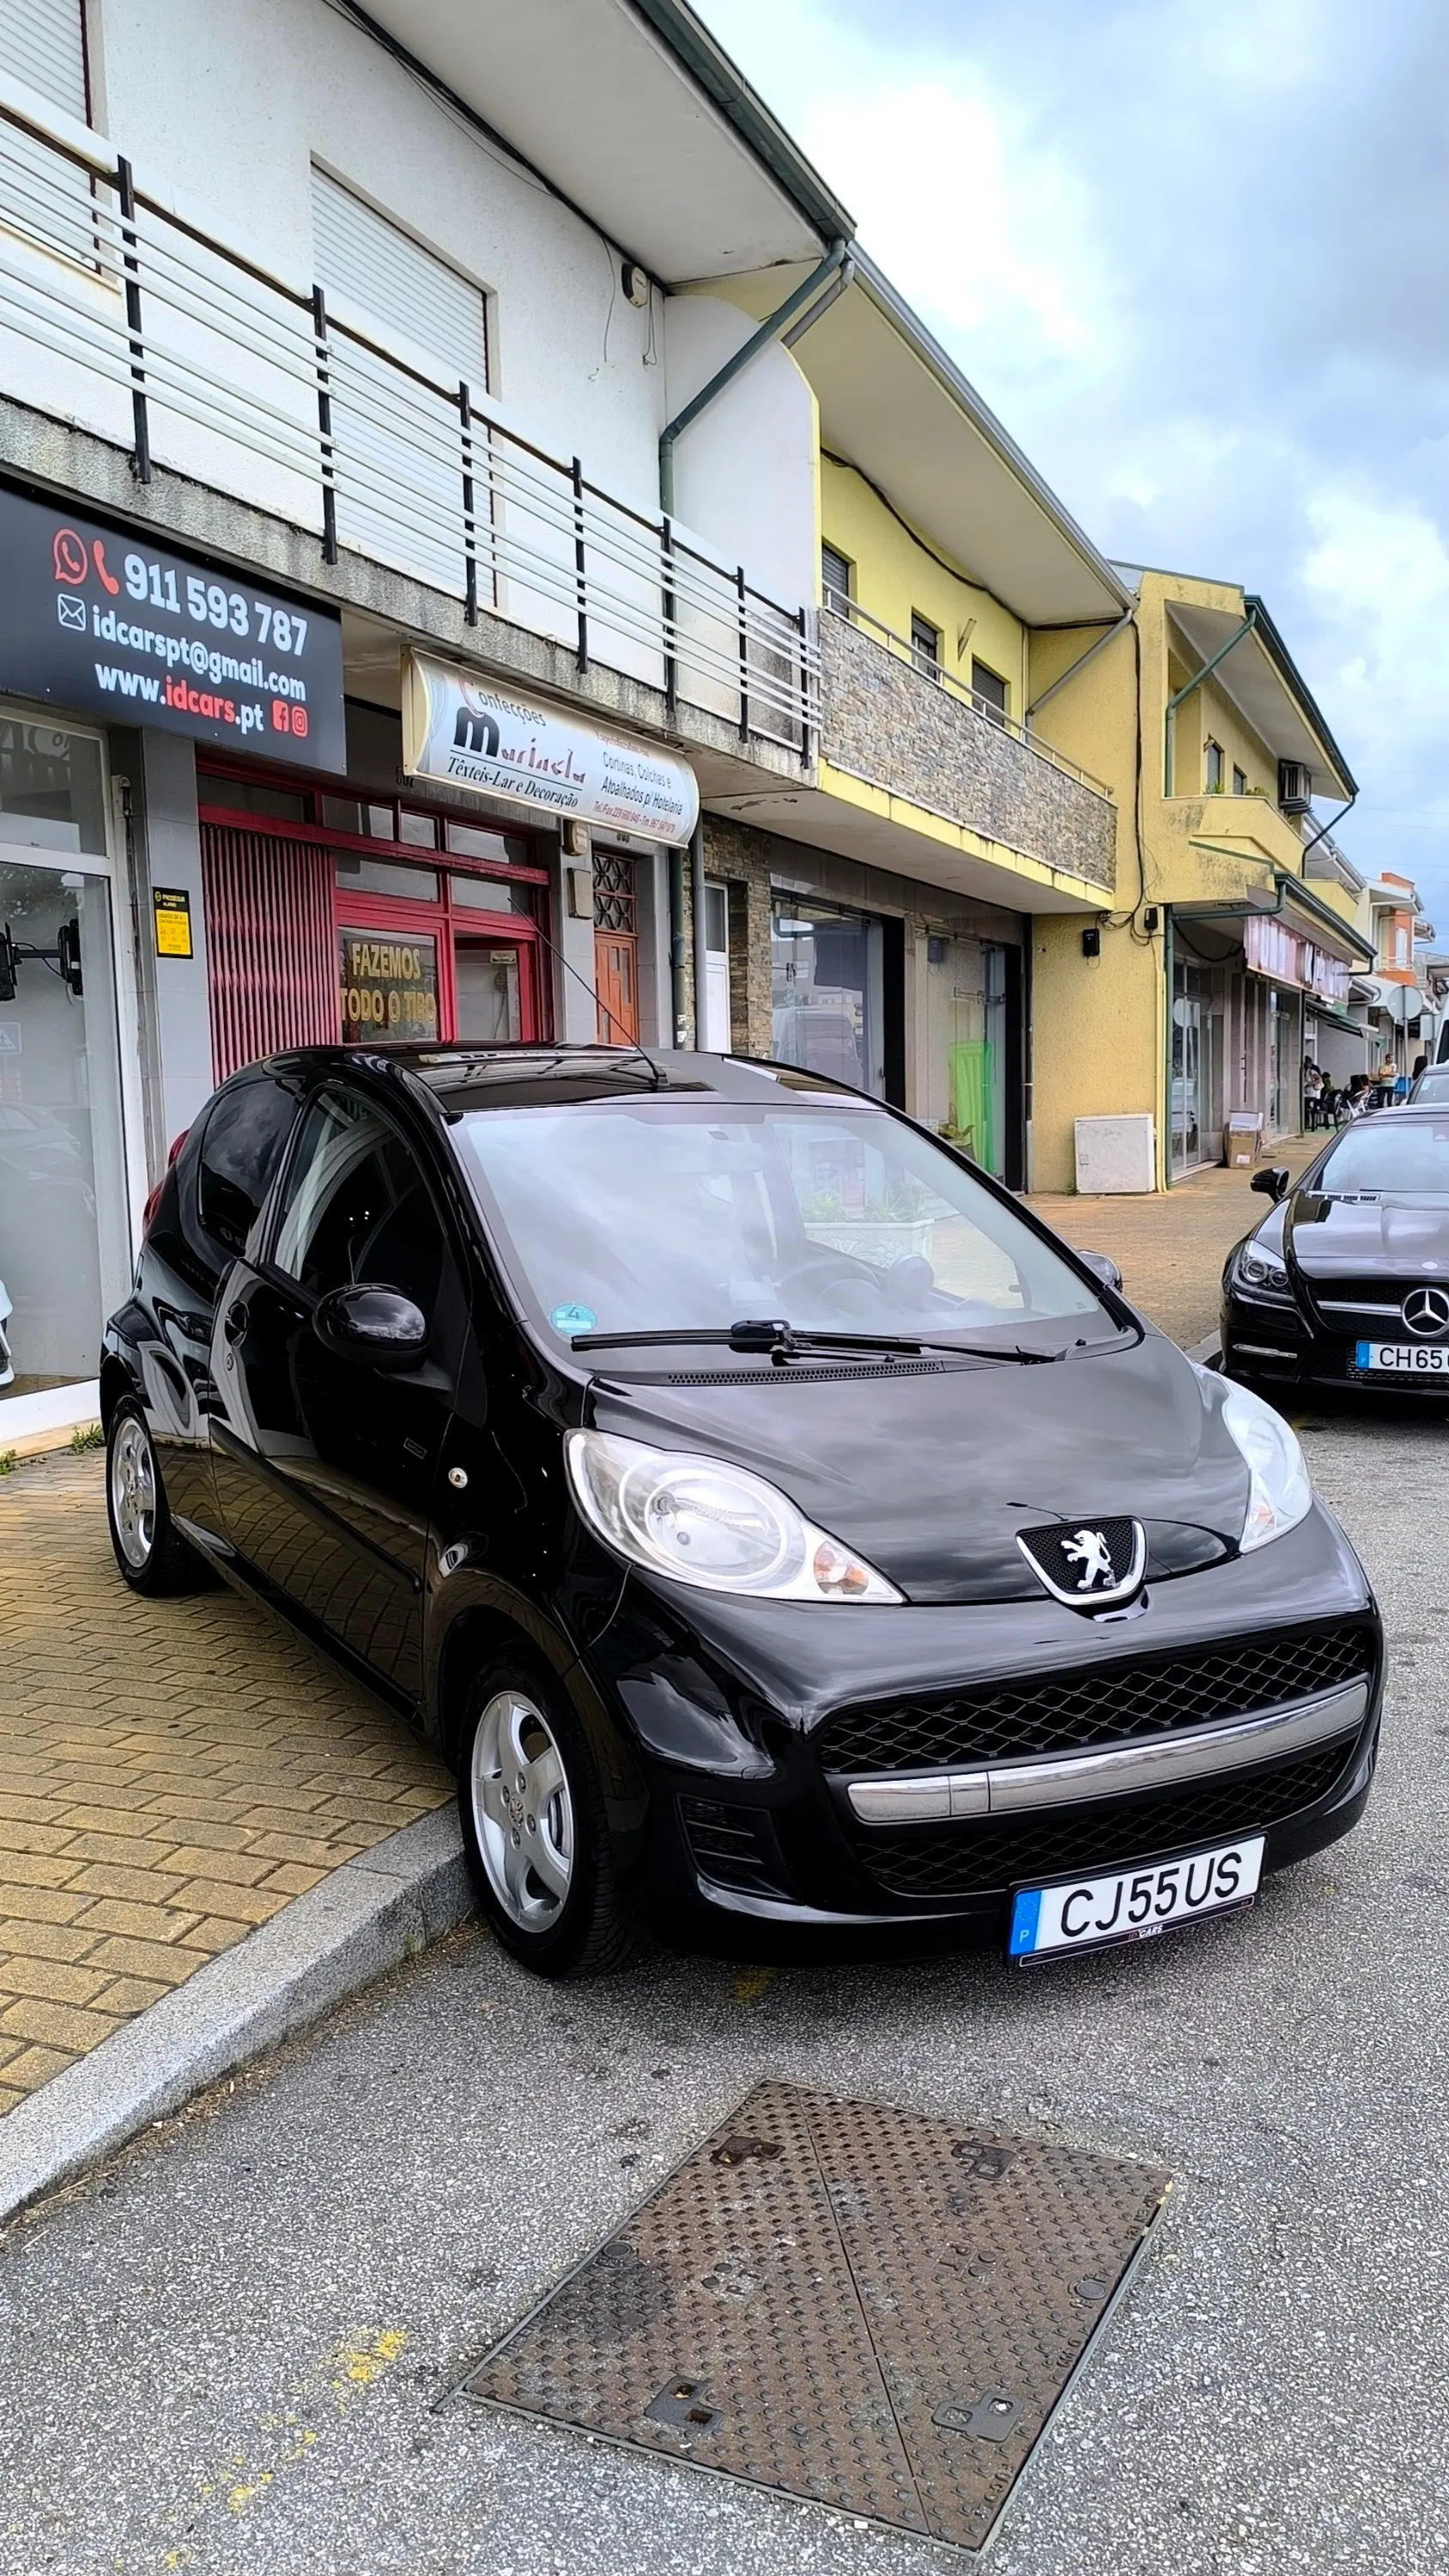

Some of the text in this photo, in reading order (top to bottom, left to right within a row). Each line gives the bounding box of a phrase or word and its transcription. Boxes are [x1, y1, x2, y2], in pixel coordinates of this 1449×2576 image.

[124, 554, 307, 656] 911 593 787
[93, 605, 306, 701] idcarspt@gmail.com
[94, 663, 264, 733] www.idcars.pt
[447, 756, 516, 790] Têxteis-Lar
[516, 781, 524, 793] e
[524, 781, 579, 808] Decoração
[603, 751, 636, 780] Cortinas,
[638, 763, 665, 787] Colchas
[601, 776, 644, 803] Atoalhados
[652, 792, 683, 815] Hotelaria
[352, 943, 421, 981] FAZEMOS
[339, 987, 437, 1024] TODO O TIPO
[568, 1306, 580, 1320] 4
[1379, 1346, 1449, 1370] CH65
[1019, 1929, 1030, 1943] P
